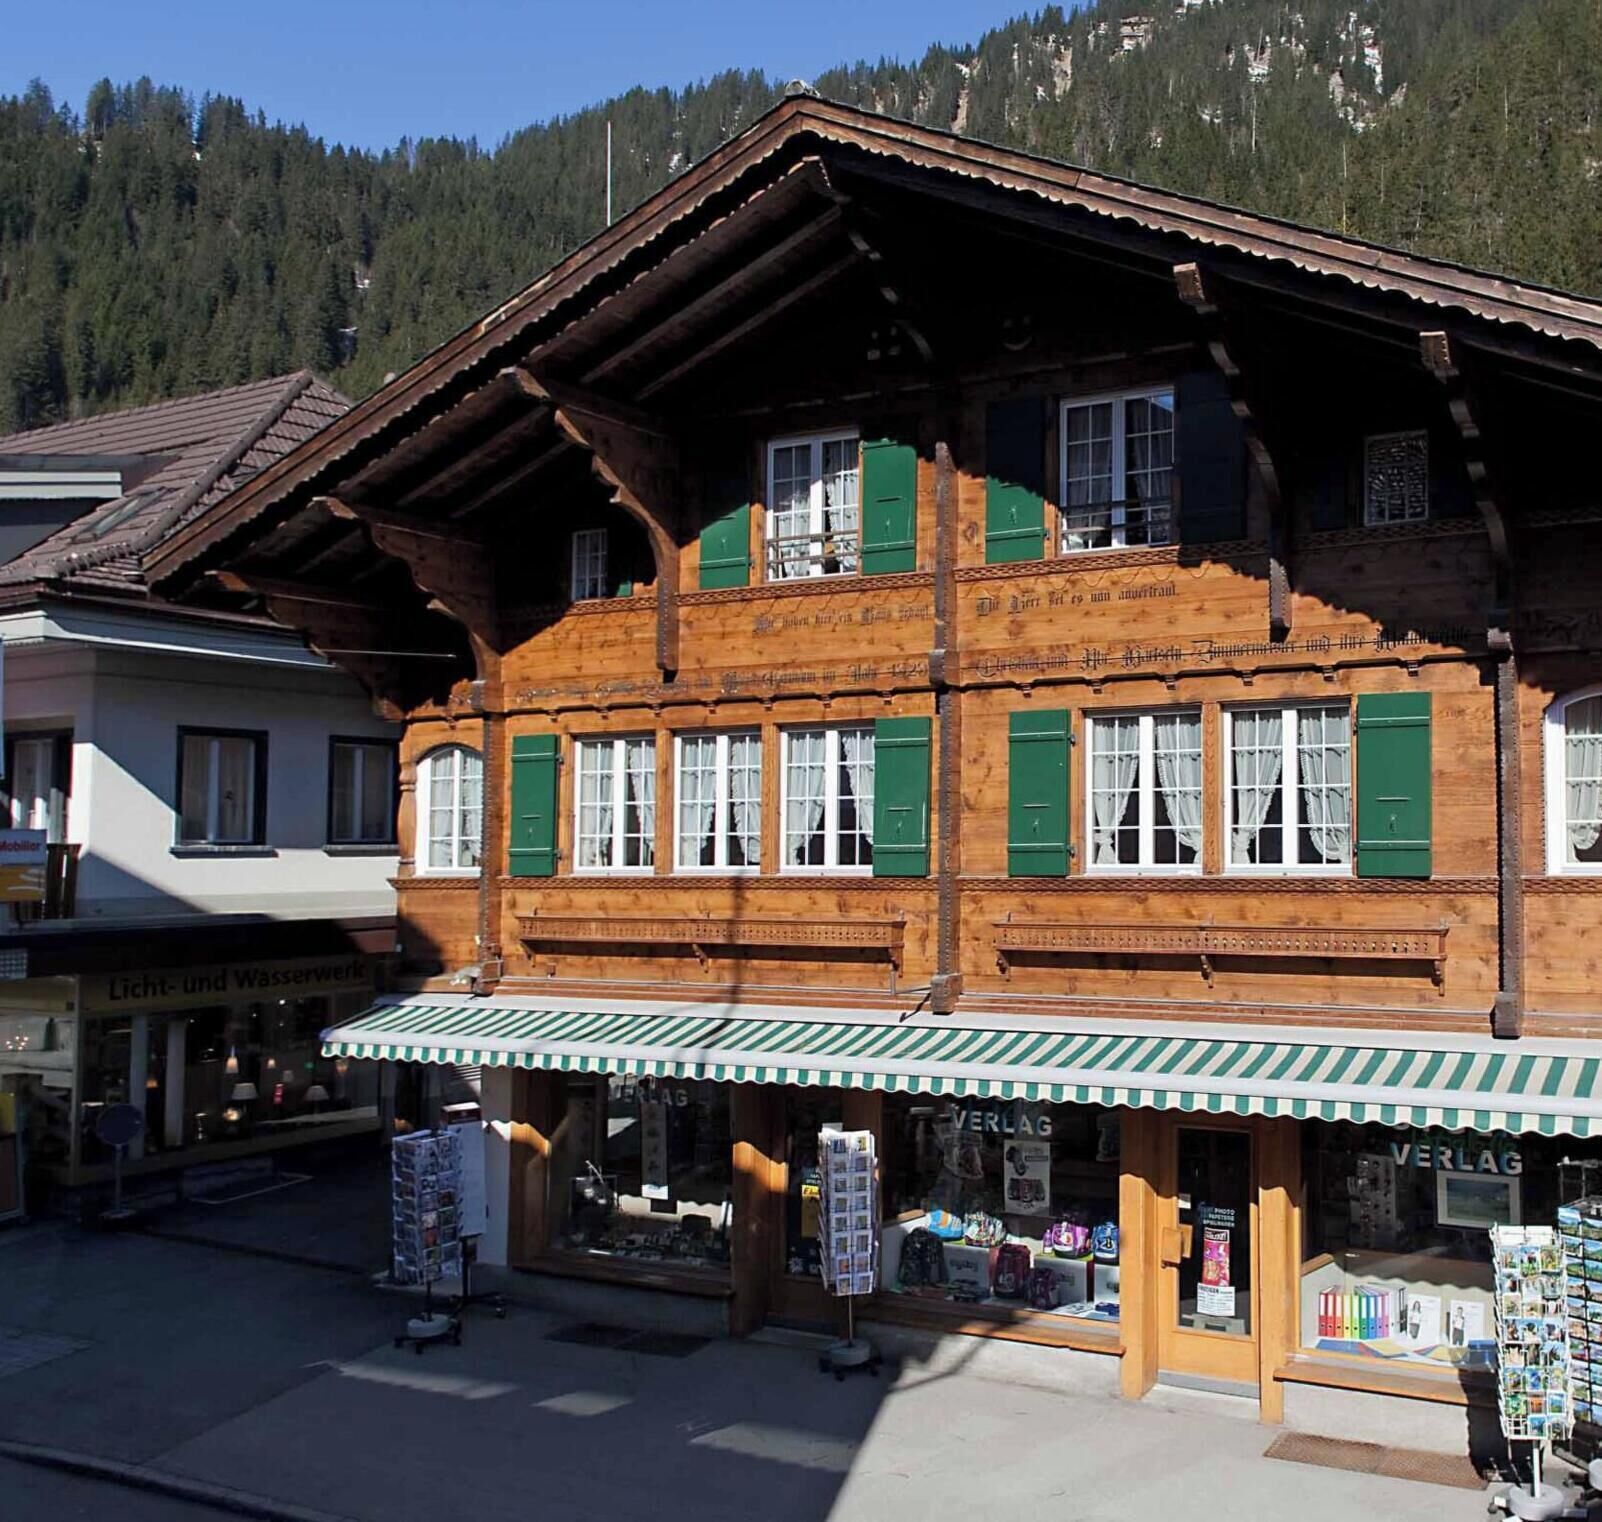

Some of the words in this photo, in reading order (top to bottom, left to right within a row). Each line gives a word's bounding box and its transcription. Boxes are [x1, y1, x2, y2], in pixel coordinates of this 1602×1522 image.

[109, 973, 176, 1001] Licht-
[183, 966, 227, 993] und
[234, 960, 367, 989] Wasserwerk
[951, 1109, 1053, 1136] VERLAG
[1390, 1141, 1523, 1176] VERLAG
